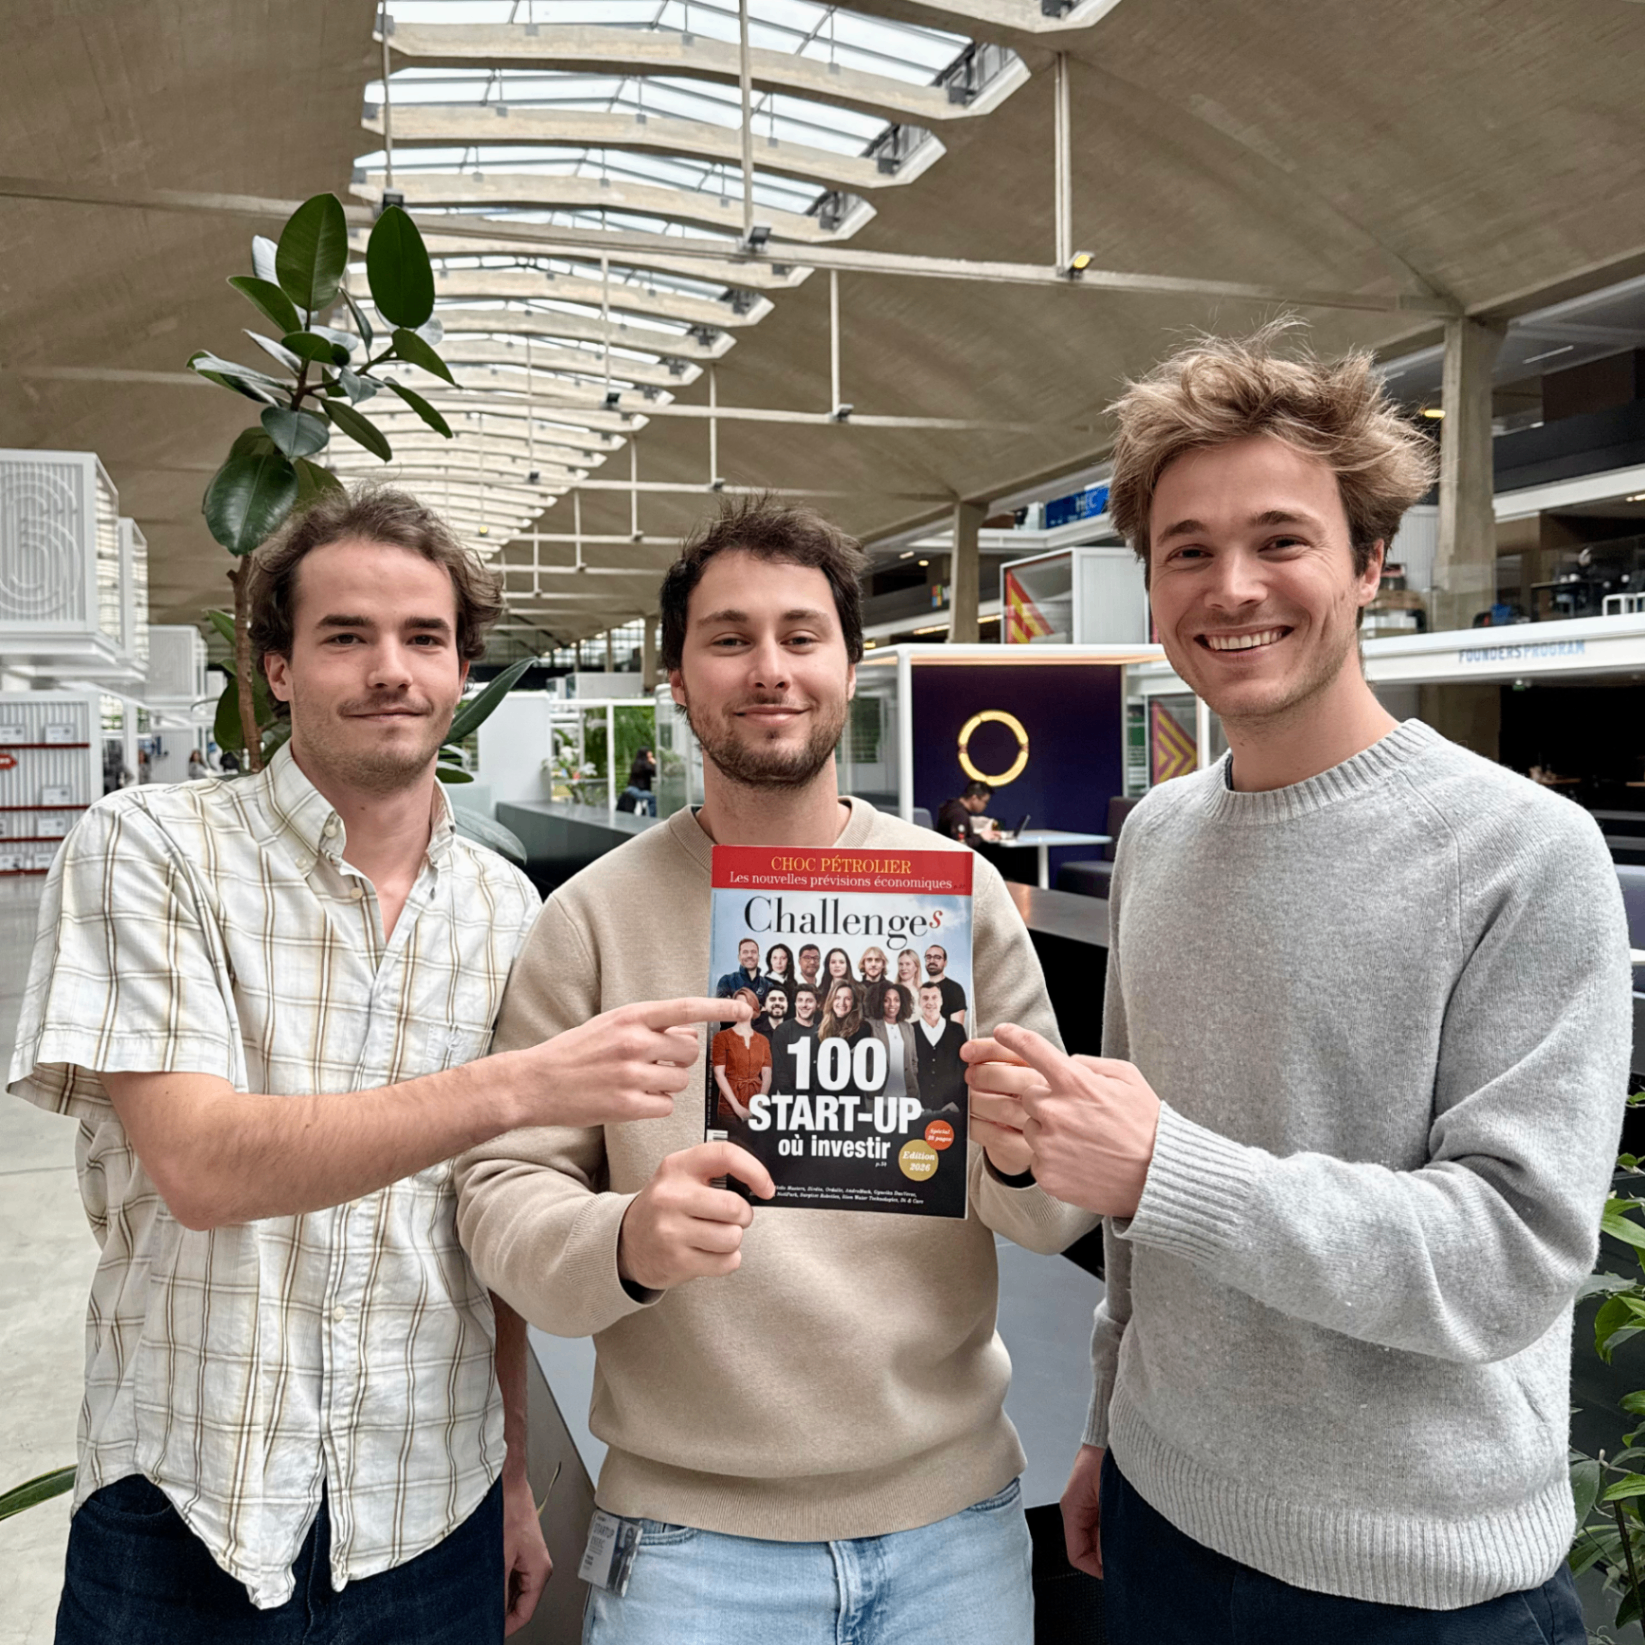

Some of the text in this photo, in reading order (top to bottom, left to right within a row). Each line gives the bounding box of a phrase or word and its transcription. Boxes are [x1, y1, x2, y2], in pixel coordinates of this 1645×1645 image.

[771, 855, 912, 874] CHOC PÉTROLIER
[730, 871, 749, 884] Les
[752, 873, 808, 885] nouvelles
[810, 874, 871, 888] prévisions
[874, 875, 952, 891] économiques
[744, 895, 943, 950] Challenges
[787, 1036, 887, 1092] 100
[748, 1093, 922, 1134] START-UP
[778, 1134, 891, 1160] où investir
[903, 1150, 936, 1172] Edition 2026
